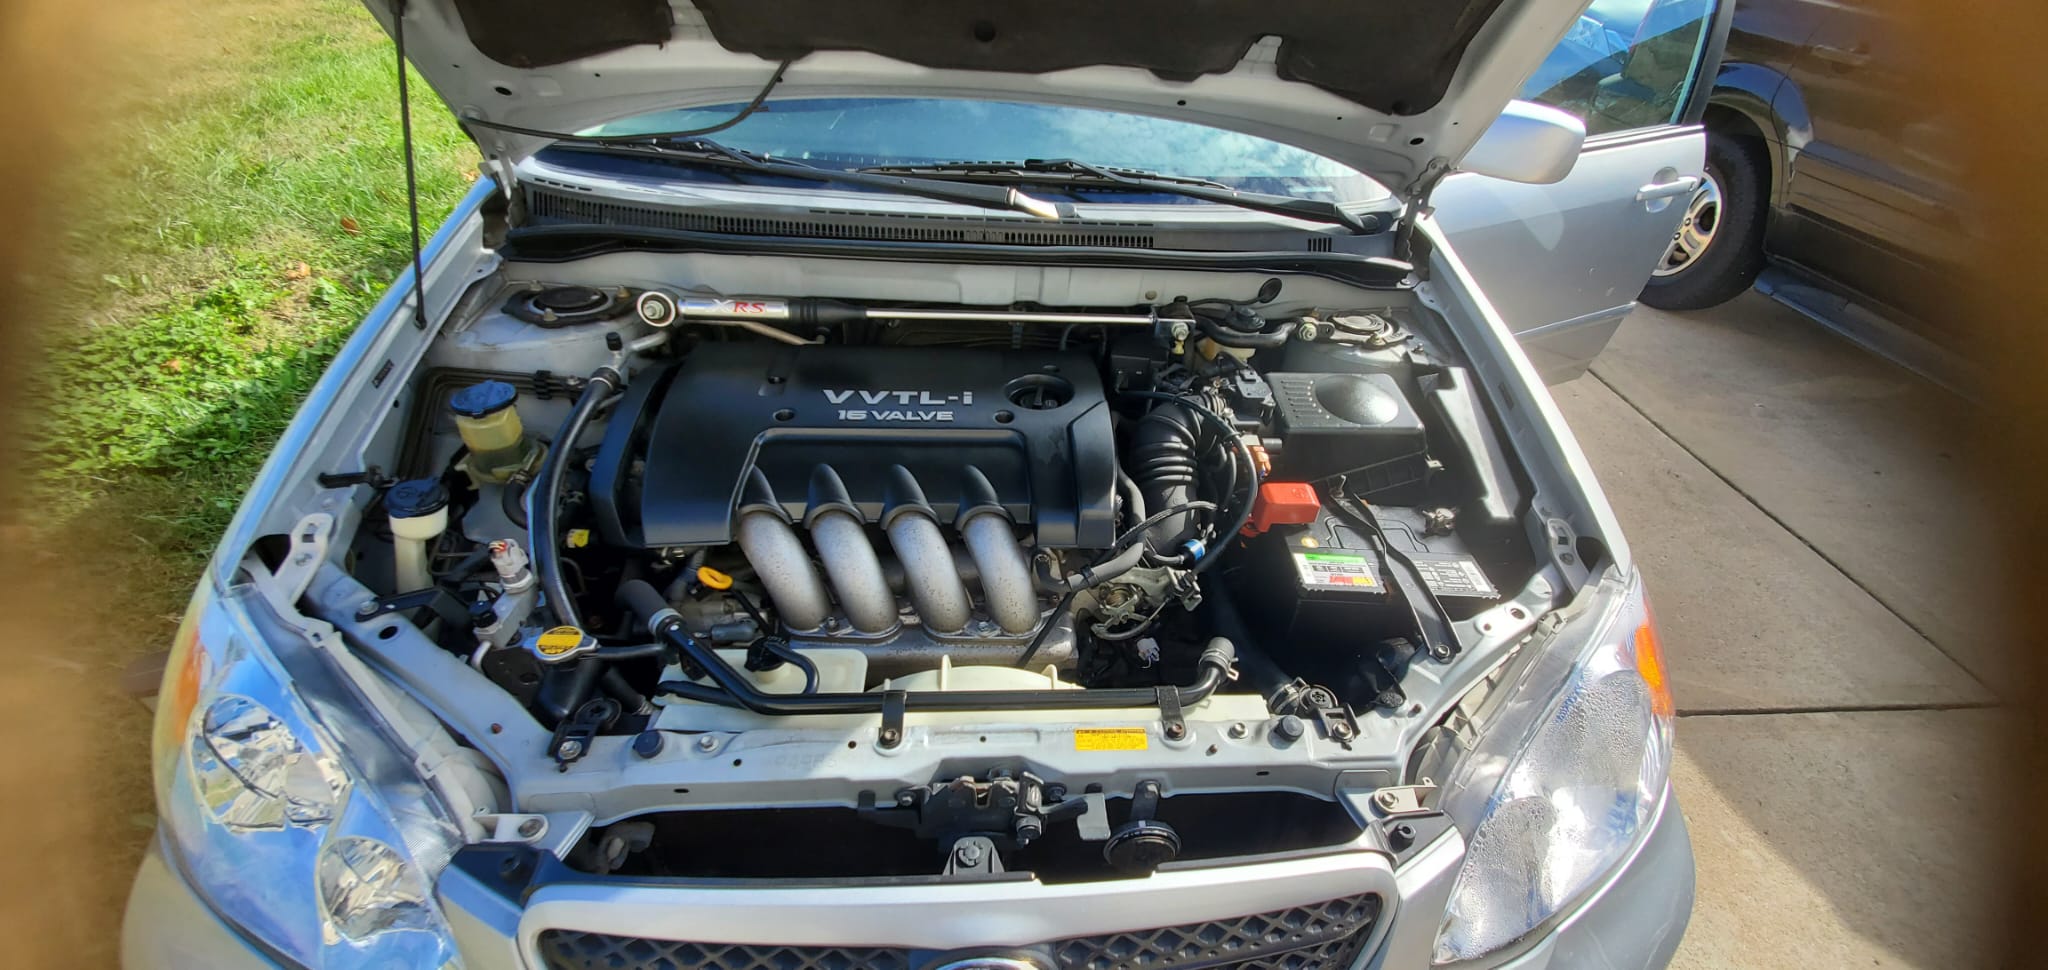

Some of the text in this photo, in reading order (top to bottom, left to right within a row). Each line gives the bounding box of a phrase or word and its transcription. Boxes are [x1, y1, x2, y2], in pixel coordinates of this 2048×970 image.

[709, 298, 766, 313] XRS
[823, 389, 973, 405] VVTL-i
[838, 409, 954, 421] 16 VALVE
